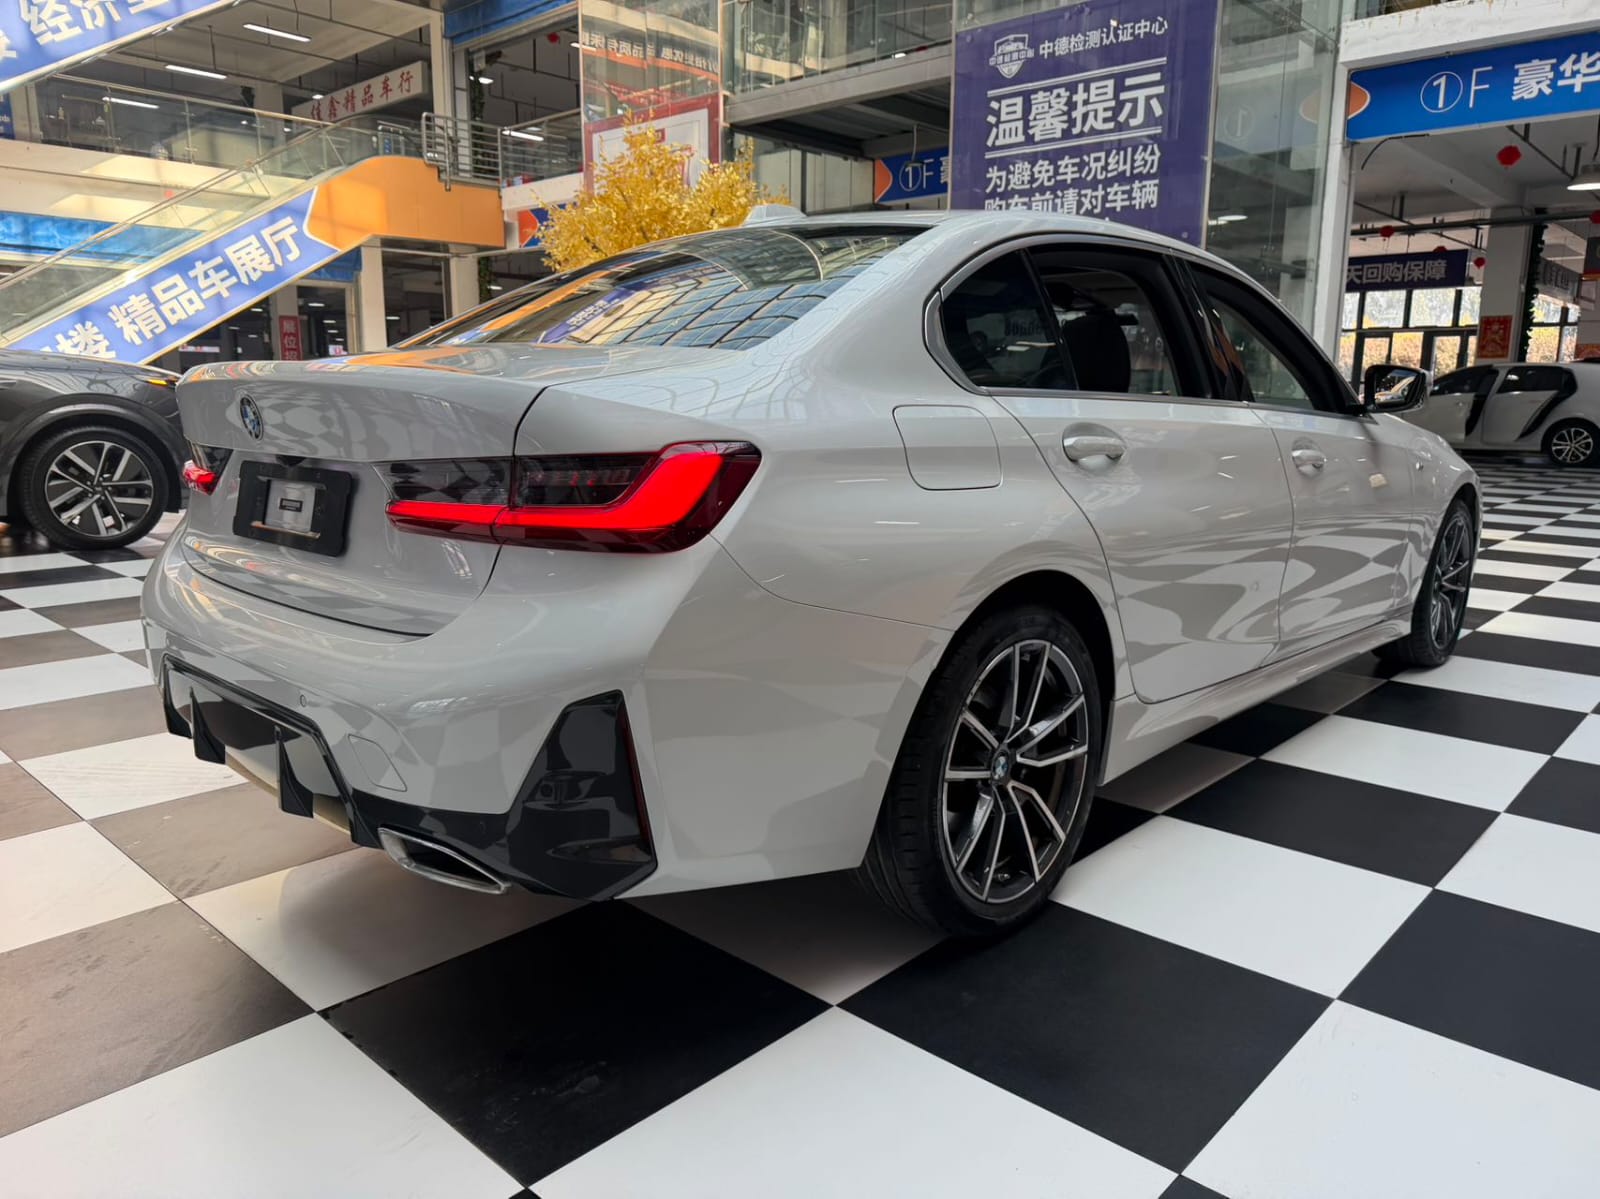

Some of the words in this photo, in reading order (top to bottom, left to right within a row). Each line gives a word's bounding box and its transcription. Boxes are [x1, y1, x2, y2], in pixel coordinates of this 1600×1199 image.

[19, 0, 169, 46] 经济
[1039, 15, 1169, 59] 中德检测认证中心
[1511, 52, 1600, 101] 豪华
[985, 72, 1166, 147] 温馨提示
[985, 144, 1161, 194] 为避免车况纠纷
[107, 216, 302, 346] 精品车展厅
[1347, 259, 1448, 284] 天回购保障
